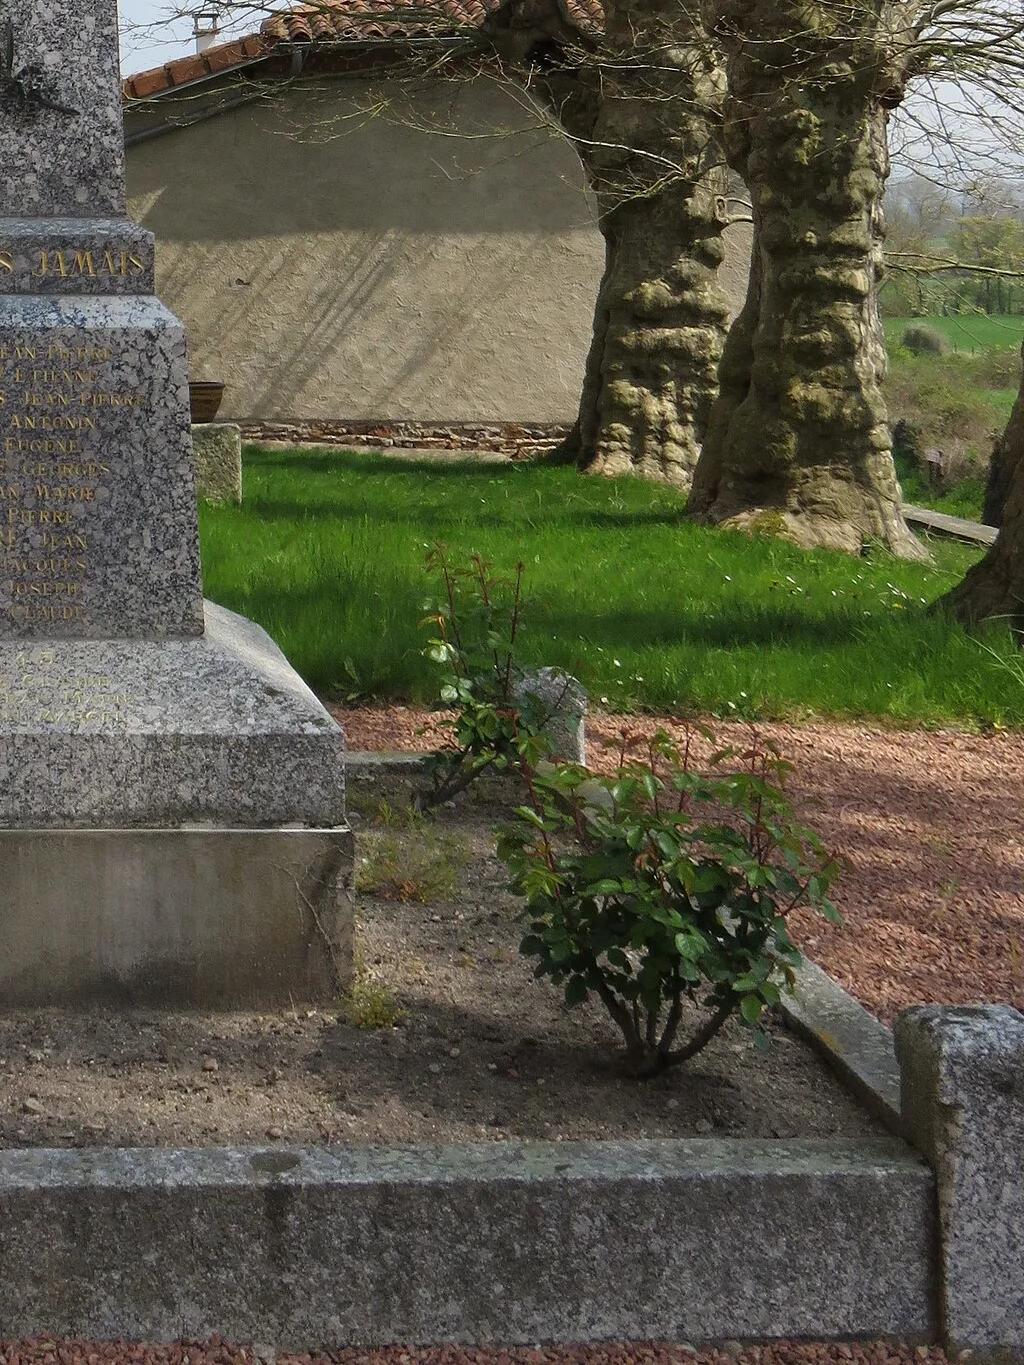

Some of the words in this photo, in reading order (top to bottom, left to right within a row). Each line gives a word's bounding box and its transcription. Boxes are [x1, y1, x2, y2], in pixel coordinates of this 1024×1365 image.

[33, 250, 146, 277] JAMAIS
[10, 415, 97, 430] ANTONIN
[36, 484, 95, 500] MARIE
[8, 508, 74, 523] PIERRE
